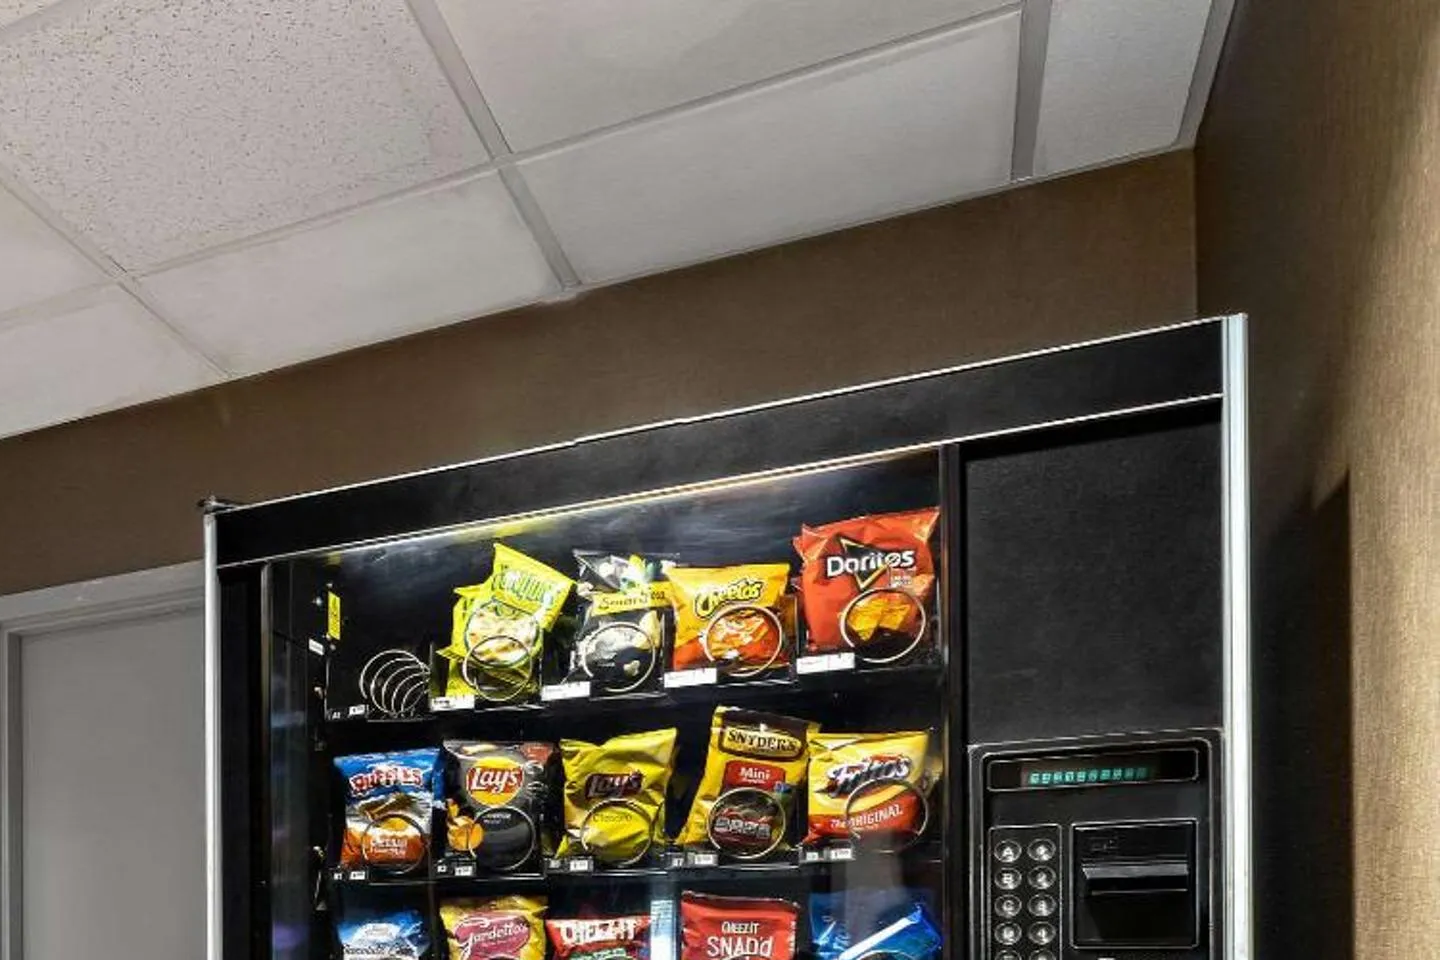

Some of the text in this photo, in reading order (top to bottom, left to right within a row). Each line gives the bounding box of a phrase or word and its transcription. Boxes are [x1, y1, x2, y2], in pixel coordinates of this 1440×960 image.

[827, 549, 916, 577] Doritos
[695, 577, 763, 618] Cheetos
[740, 766, 771, 781] Mini
[847, 803, 903, 828] ORIGINAL
